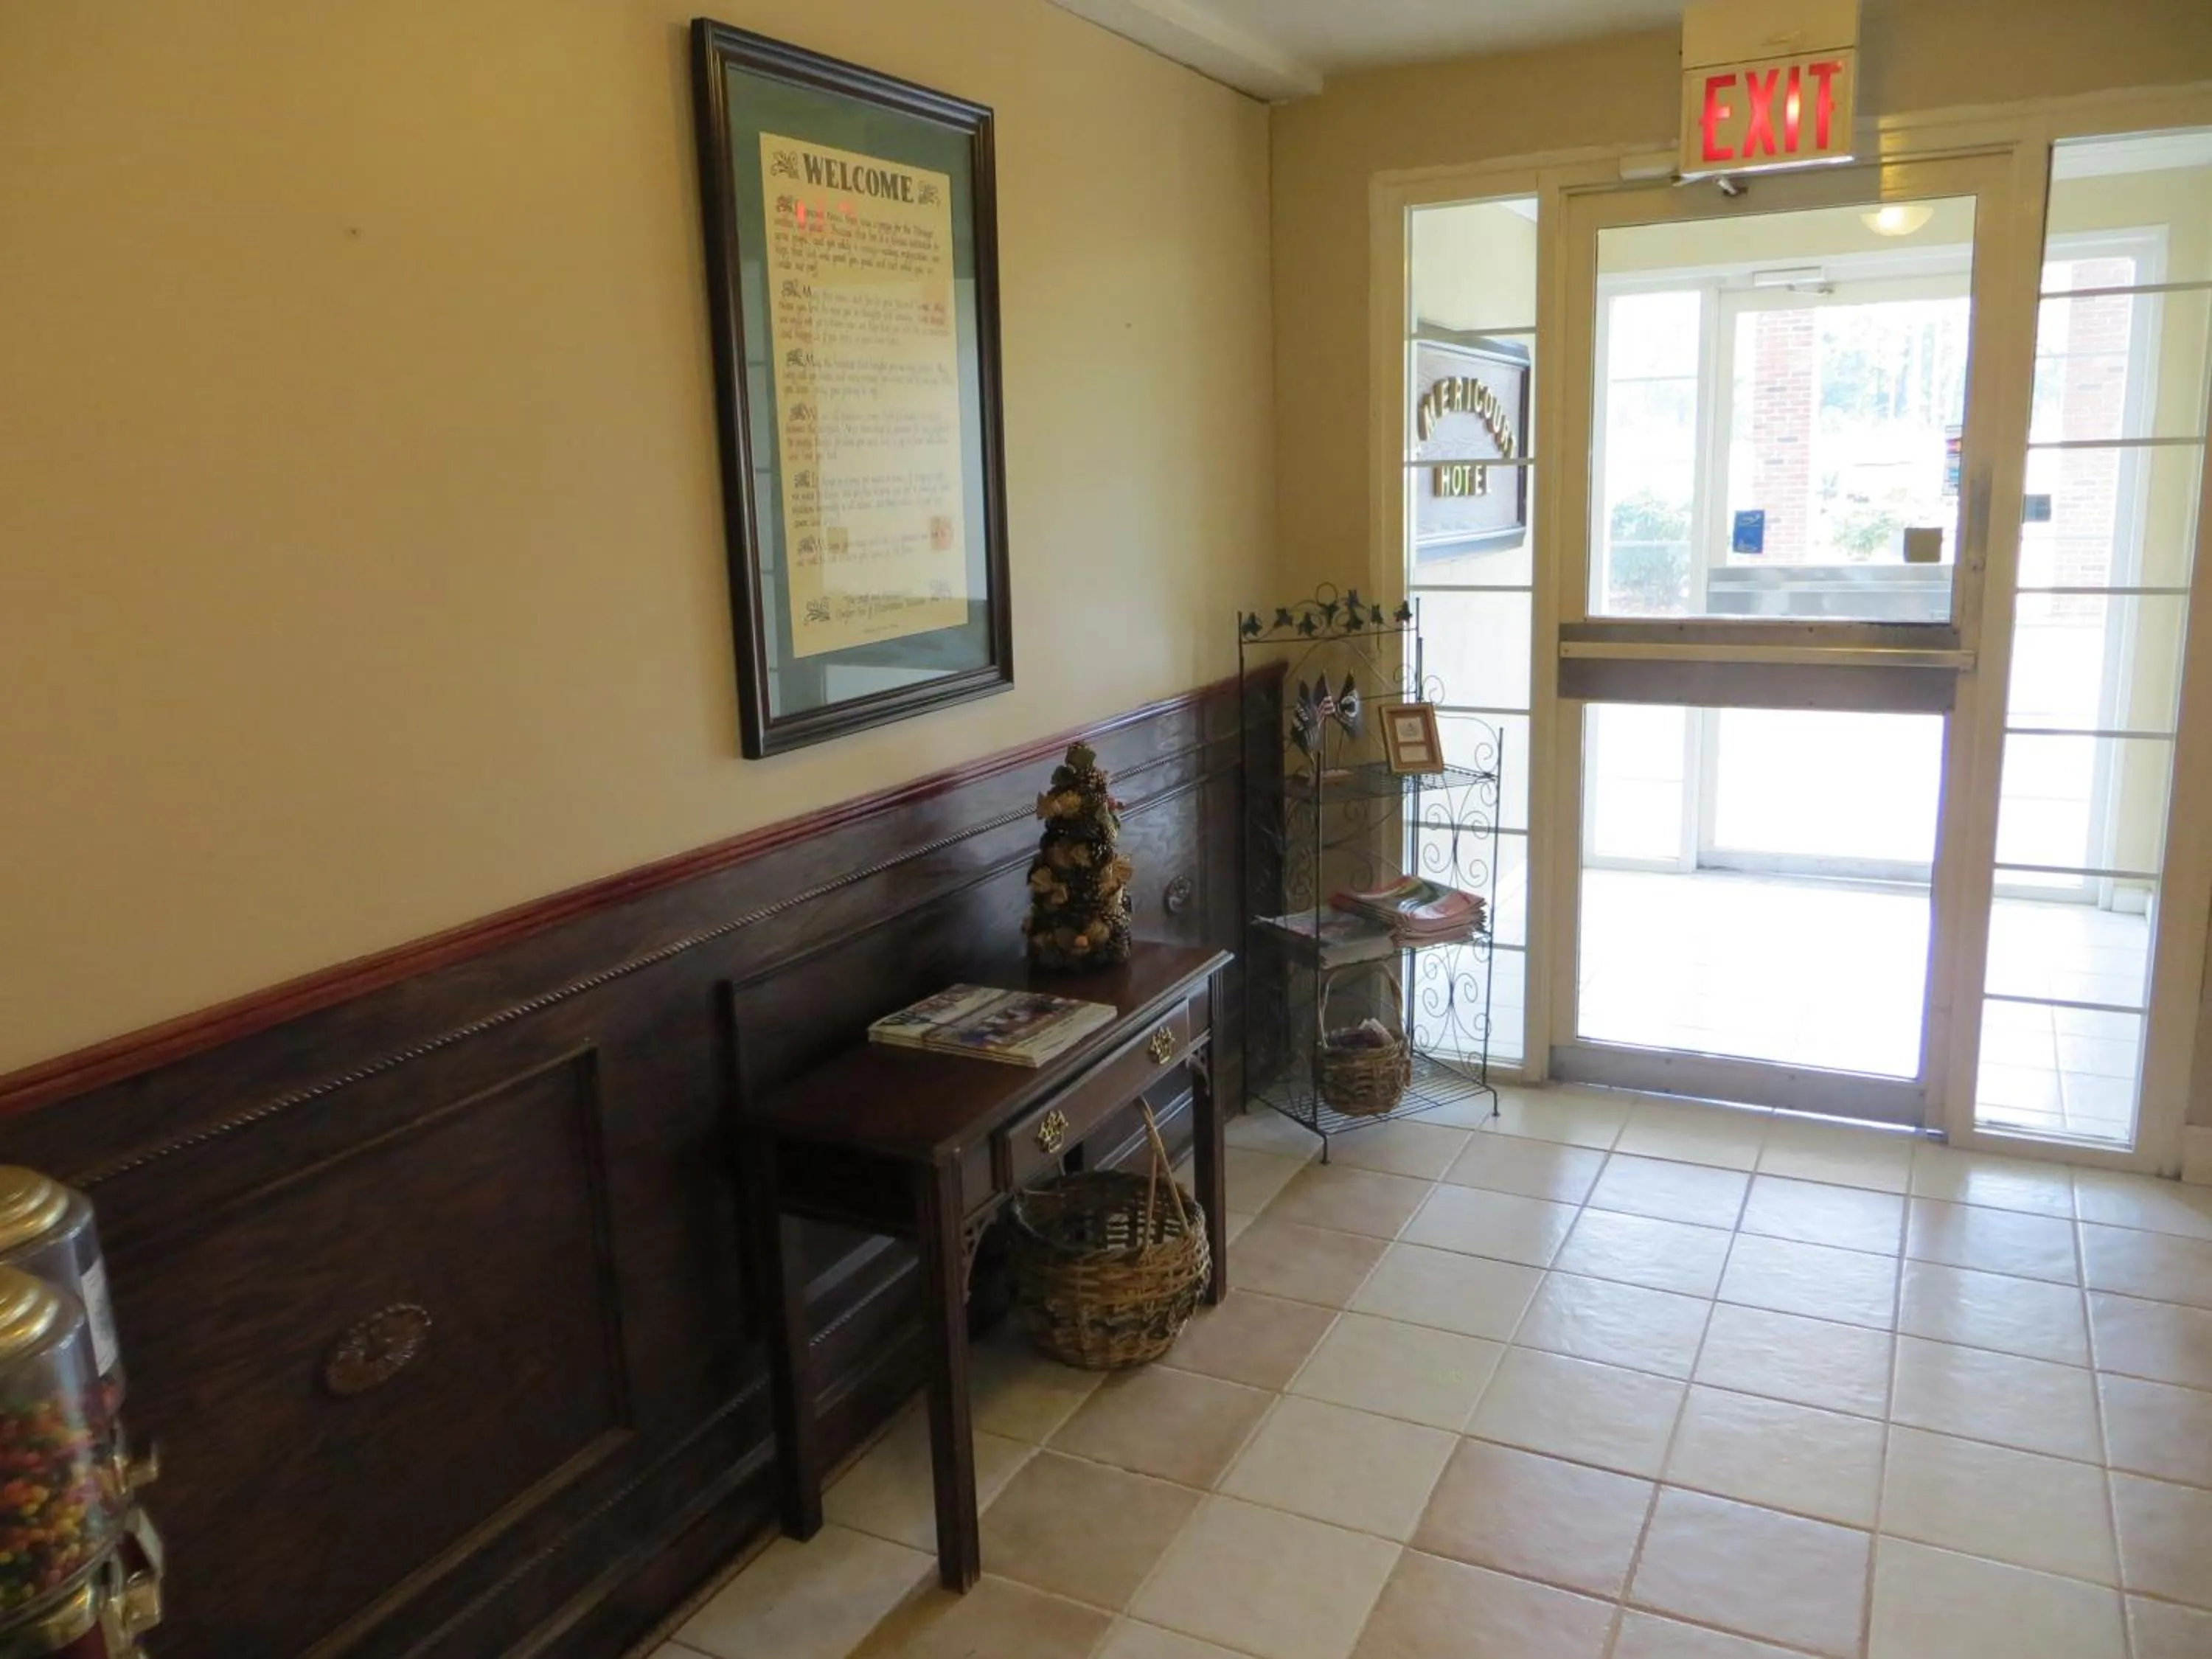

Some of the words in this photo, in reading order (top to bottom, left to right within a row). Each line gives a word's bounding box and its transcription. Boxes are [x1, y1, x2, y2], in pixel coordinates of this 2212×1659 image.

[1700, 61, 1842, 163] EXIT
[802, 152, 915, 204] WELCOME
[1416, 376, 1517, 459] MERICOURT
